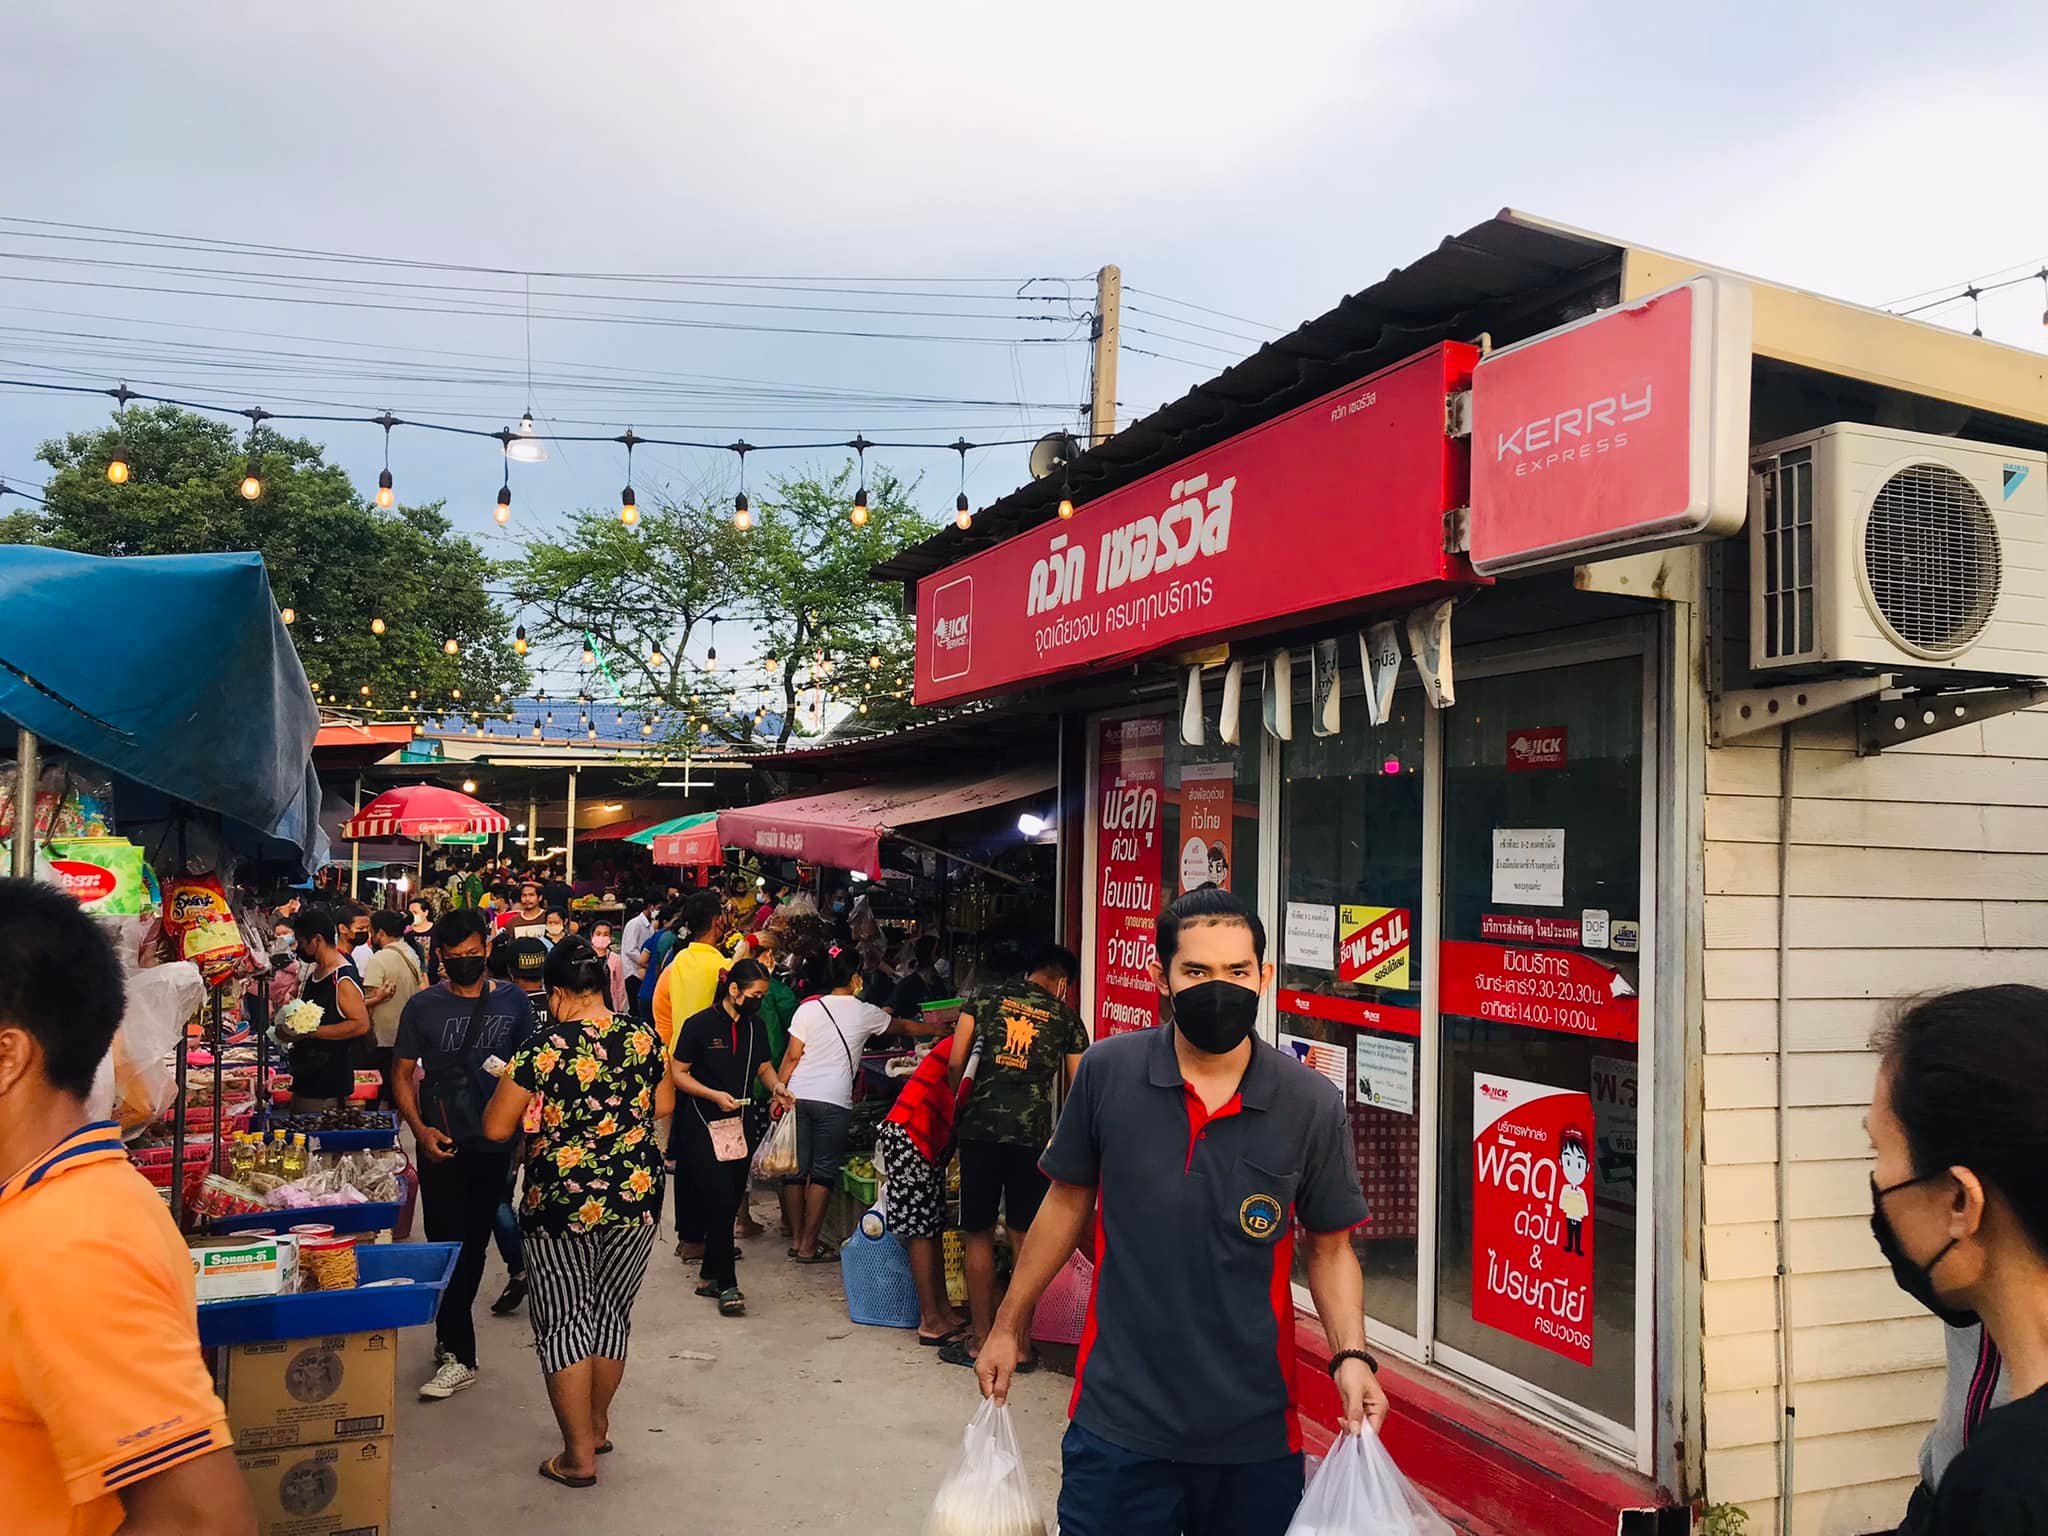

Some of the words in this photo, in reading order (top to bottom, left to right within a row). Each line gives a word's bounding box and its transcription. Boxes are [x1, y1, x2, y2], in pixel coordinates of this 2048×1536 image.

[1497, 383, 1652, 462] KERRY
[1515, 432, 1628, 477] EXPRESS
[1027, 534, 1086, 617] ควิก
[1035, 610, 1101, 659] จุดเดียวจบ
[1105, 576, 1213, 633] ครบทุกบริการ
[1103, 777, 1158, 848] พัสดุ
[1191, 805, 1221, 830] ทั่วไทย
[1111, 830, 1138, 862] ด่วน
[1102, 867, 1154, 911] โอนเงิน
[1107, 929, 1157, 970] จ่ายบิล
[1482, 917, 1535, 941] บริการส่งพัสดุ
[1535, 918, 1579, 939] ในประเทศ
[1503, 950, 1570, 977] เปิดบริการ
[1102, 995, 1152, 1029] ถ่ายเอกสาร
[440, 1015, 515, 1052] NKE
[1477, 1134, 1557, 1218] พัสดุ
[1514, 1203, 1560, 1246] ด่วน
[1529, 1244, 1543, 1270] &
[1488, 1248, 1587, 1323] ไปรษณีย์
[1534, 1316, 1591, 1350] ครบวงจร
